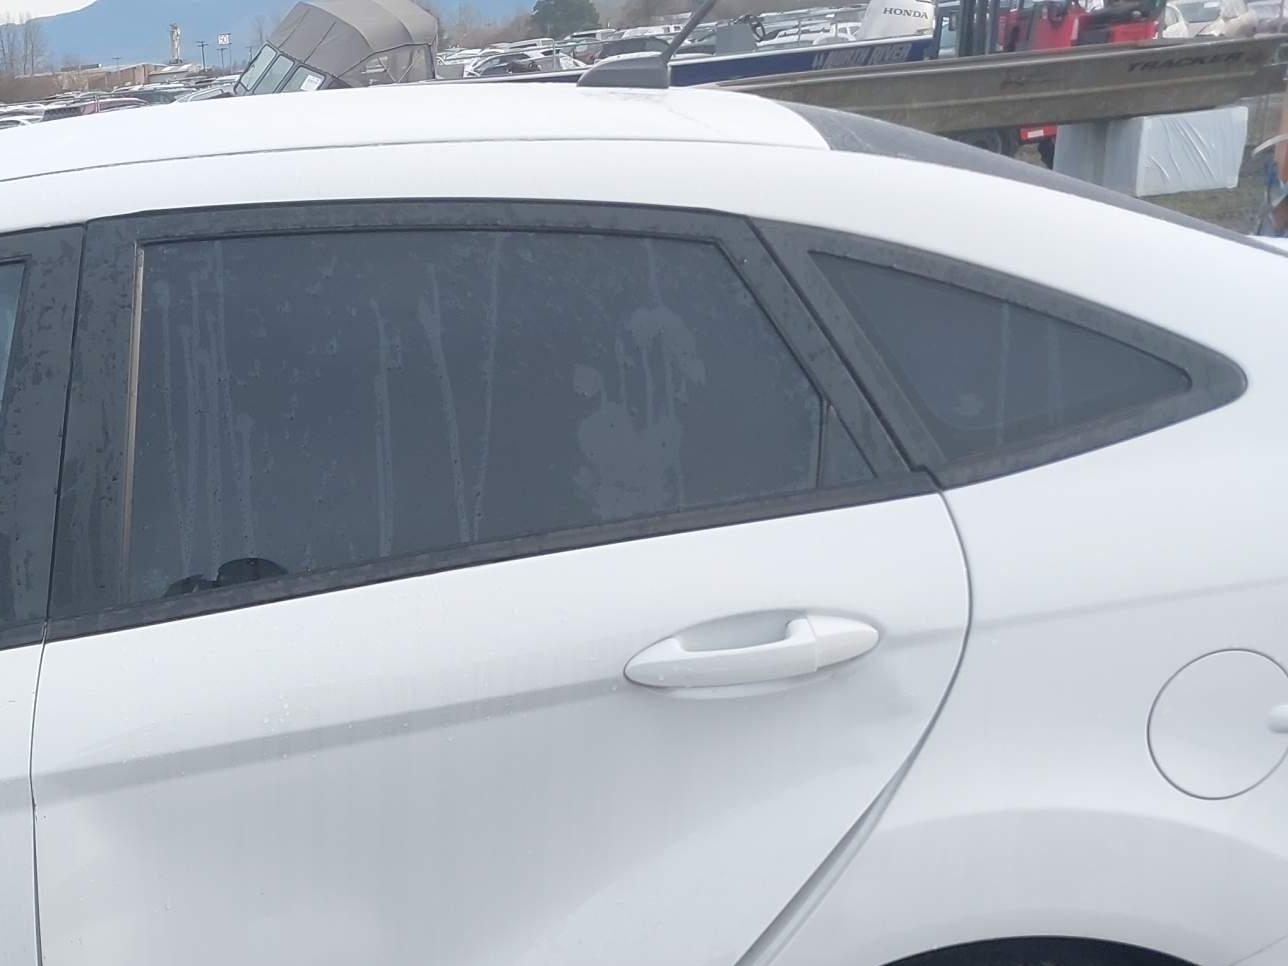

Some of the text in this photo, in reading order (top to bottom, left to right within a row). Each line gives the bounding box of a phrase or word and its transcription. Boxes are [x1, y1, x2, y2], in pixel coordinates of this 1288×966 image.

[882, 8, 928, 20] HONDA
[869, 42, 912, 64] RIVER
[1127, 51, 1244, 72] TRACKER
